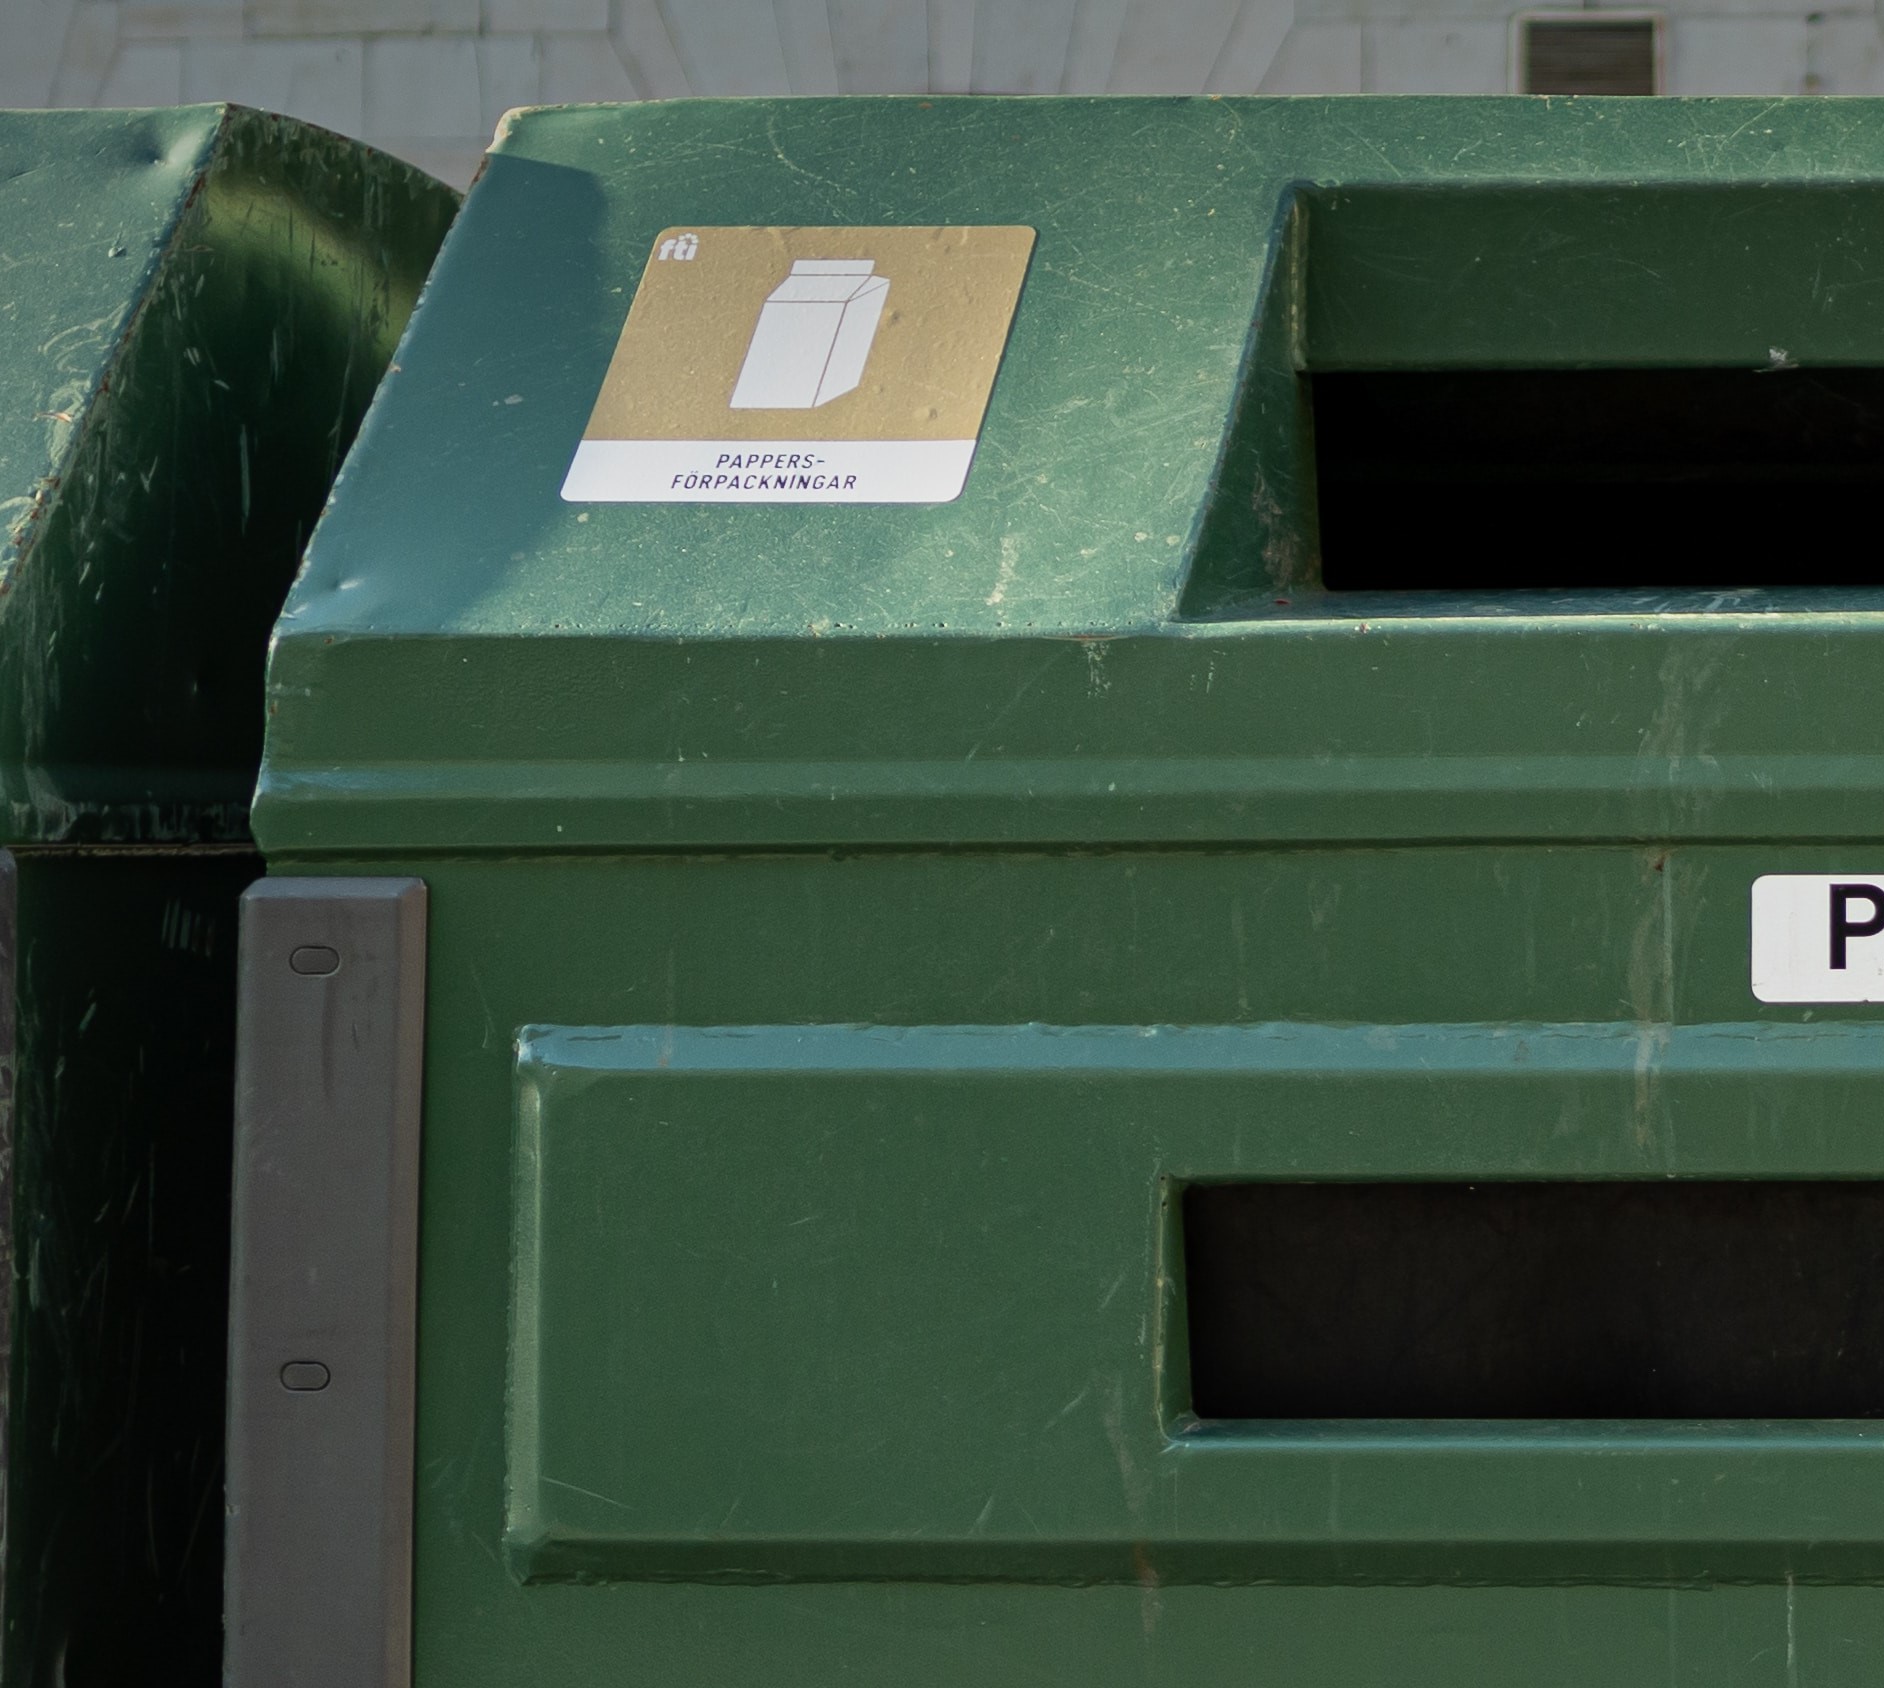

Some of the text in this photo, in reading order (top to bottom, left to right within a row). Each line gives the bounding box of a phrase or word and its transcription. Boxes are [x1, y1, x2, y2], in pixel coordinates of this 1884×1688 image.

[658, 233, 698, 260] fti
[716, 453, 826, 470] PAPPERS-
[671, 471, 858, 490] FÖRPACKNINGAR
